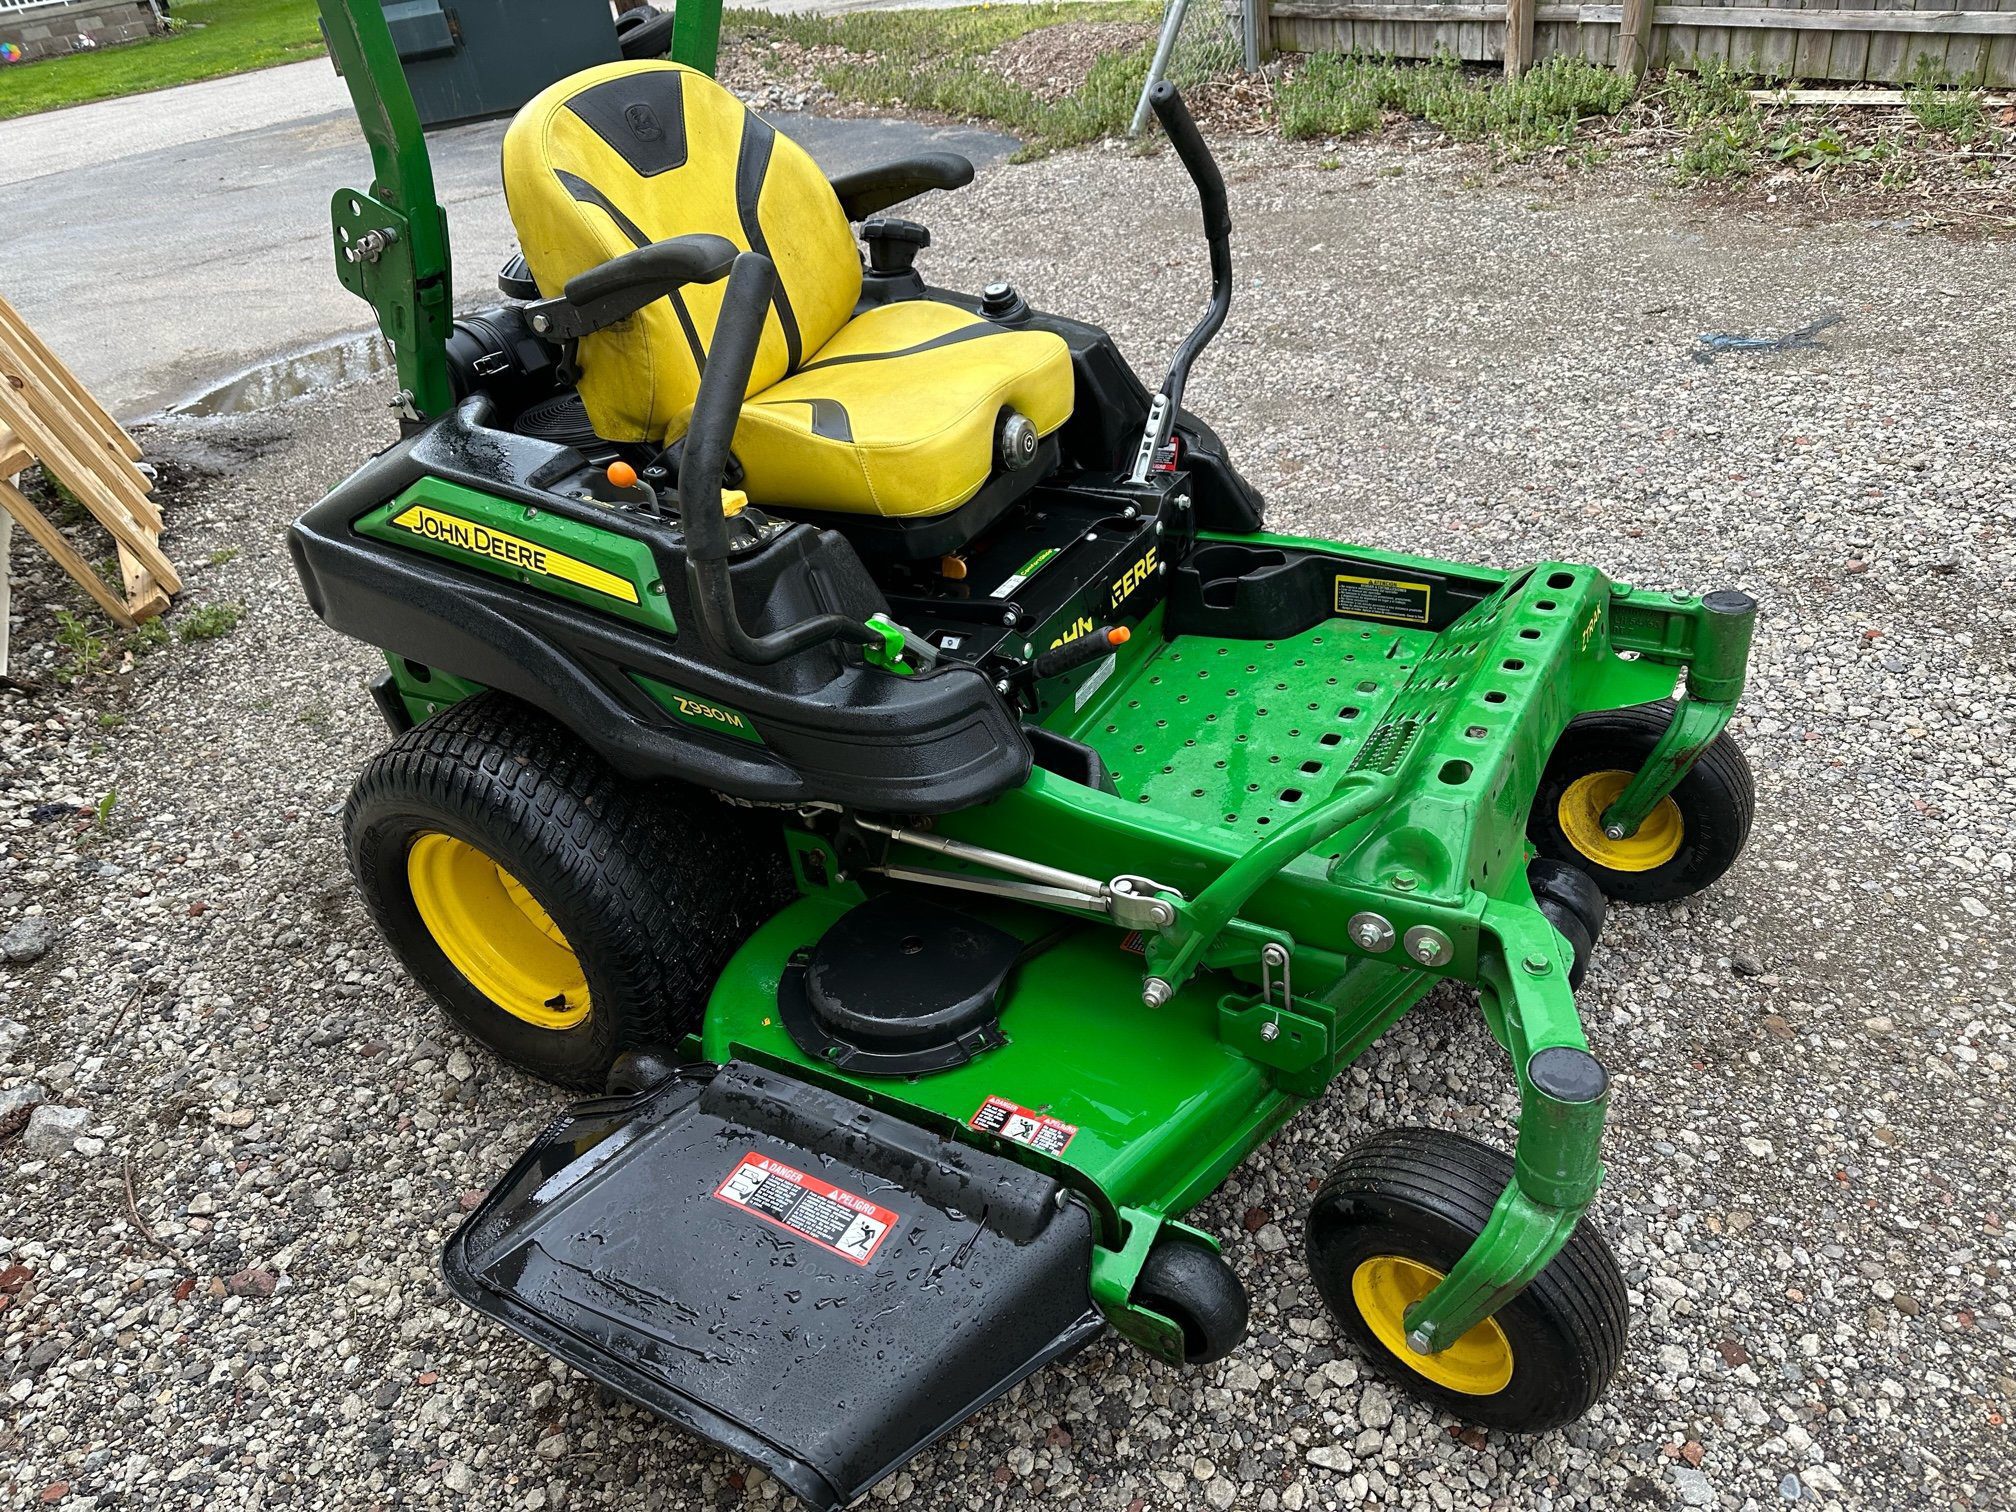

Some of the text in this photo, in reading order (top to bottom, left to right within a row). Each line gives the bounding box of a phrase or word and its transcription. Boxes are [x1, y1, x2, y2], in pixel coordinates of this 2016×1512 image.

[413, 510, 547, 572] JOHN DEERE
[1111, 546, 1158, 609] EERE
[994, 1097, 1019, 1111] DANGER
[769, 1163, 804, 1184] DANGER
[838, 1193, 877, 1216] PELIGRO
